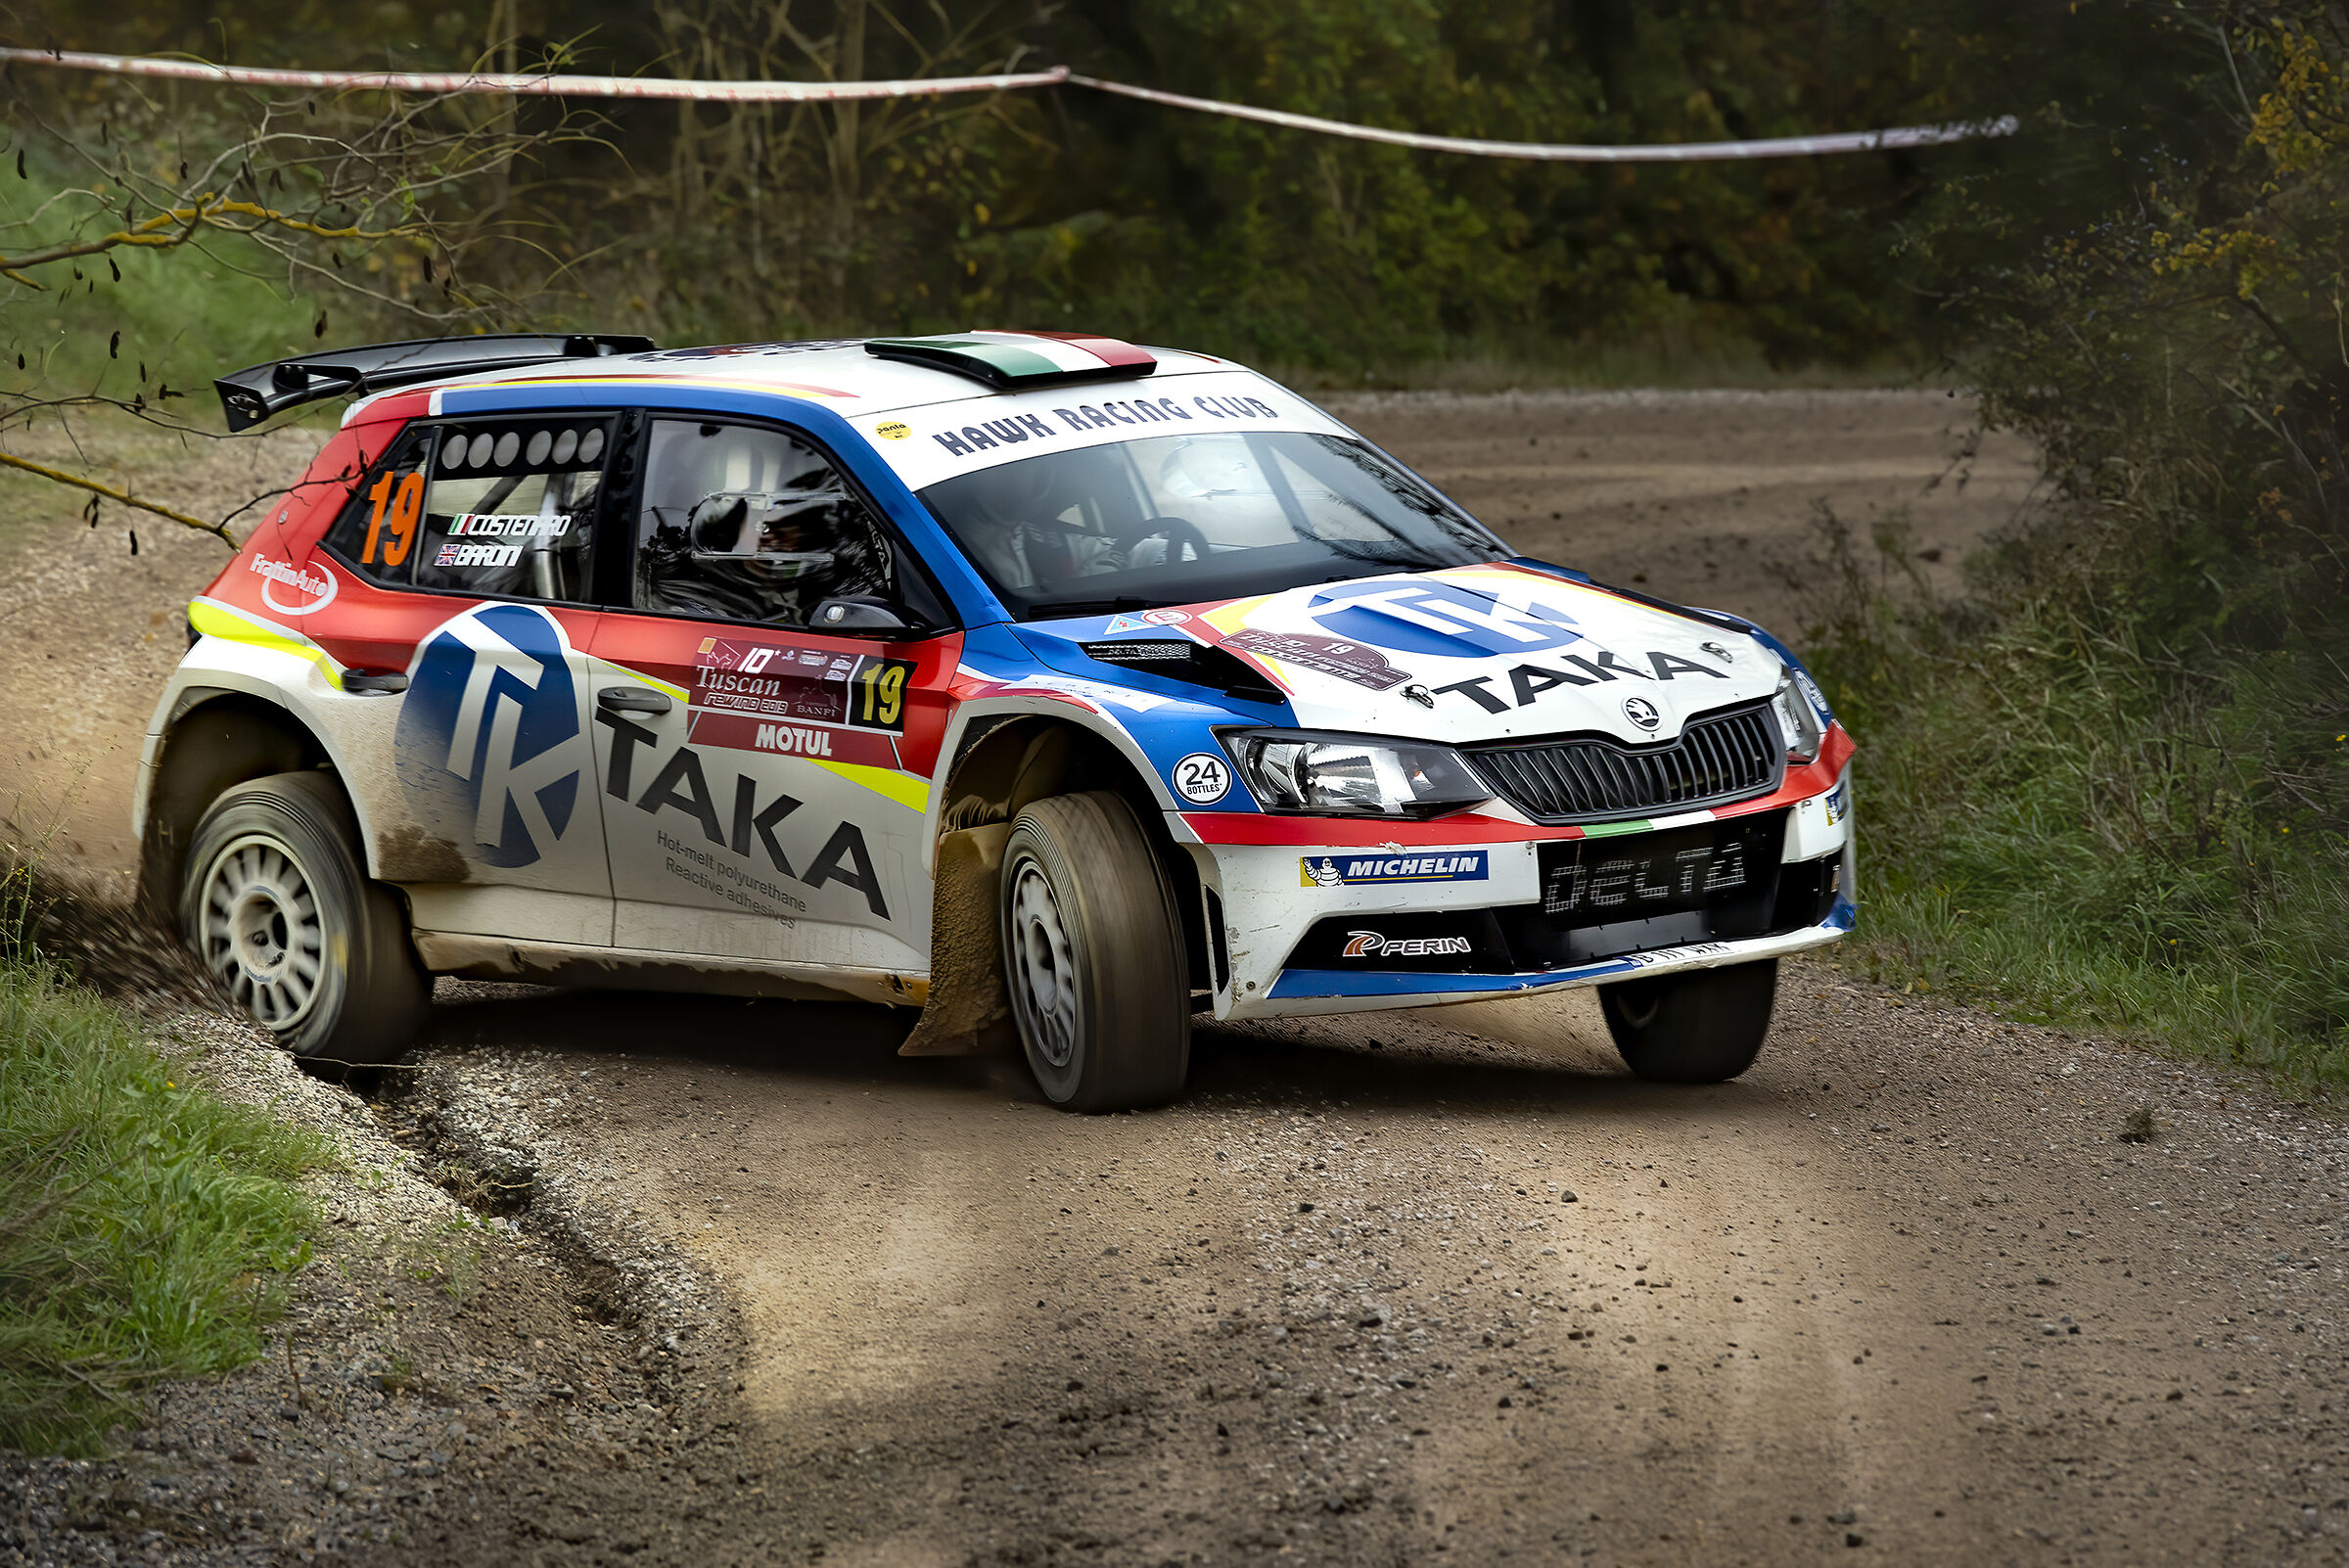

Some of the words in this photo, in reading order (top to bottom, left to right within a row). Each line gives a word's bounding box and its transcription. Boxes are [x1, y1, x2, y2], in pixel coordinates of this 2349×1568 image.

[932, 413, 1057, 457] HAWK
[1052, 397, 1194, 431] RACING
[1193, 396, 1278, 419] CLUB
[360, 471, 424, 567] 19
[1321, 642, 1356, 655] 19
[696, 665, 781, 696] Tuscan
[861, 664, 905, 724] 19
[1430, 651, 1730, 715] TAKA
[755, 723, 832, 757] MOTUL
[1183, 761, 1221, 786] 24
[1186, 784, 1221, 795] BOTTLES
[595, 705, 892, 922] TAKA
[657, 830, 714, 869] Hot-melt
[717, 861, 807, 912] polyurethane
[1348, 856, 1479, 877] MICHELIN
[666, 856, 723, 896] Reactive
[727, 889, 797, 930] adhesives
[1380, 937, 1472, 956] PERIN
